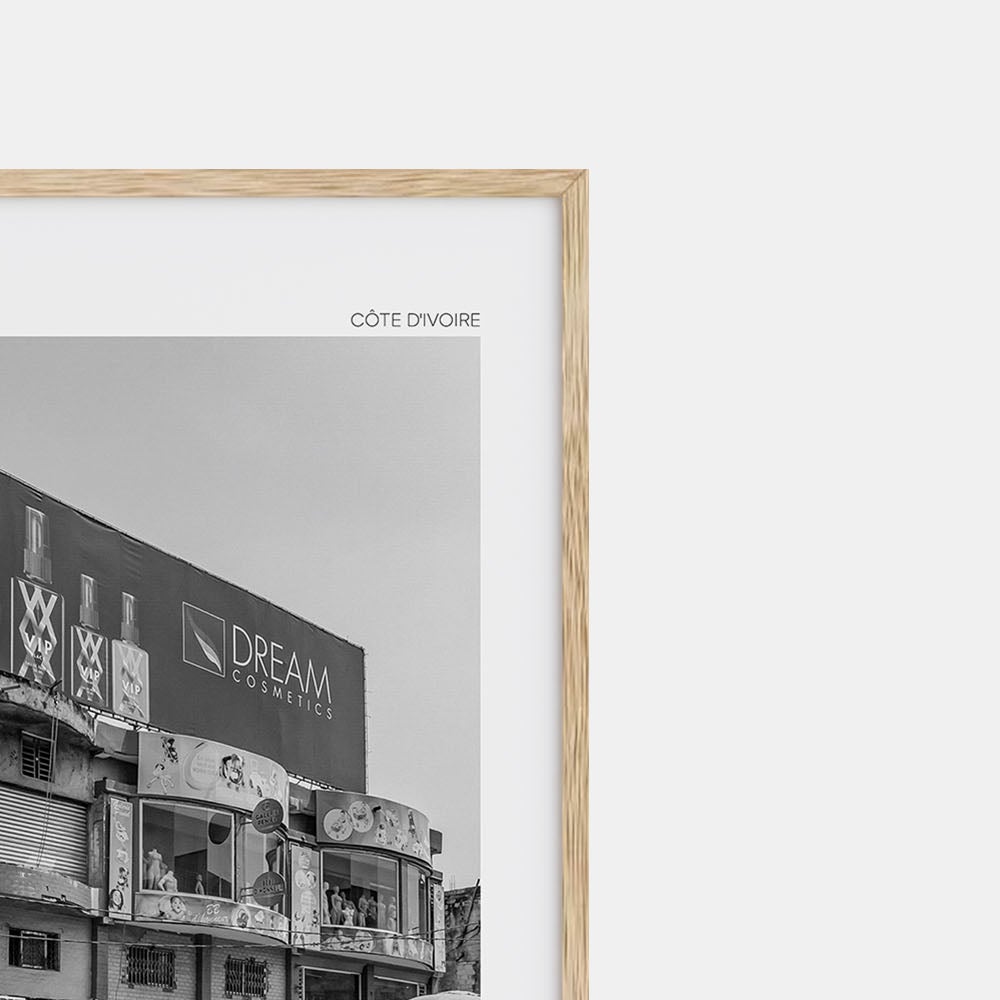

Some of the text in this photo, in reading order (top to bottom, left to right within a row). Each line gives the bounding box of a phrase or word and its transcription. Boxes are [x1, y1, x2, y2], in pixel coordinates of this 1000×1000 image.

[350, 308, 481, 328] CÔTE D'IVOIRE
[24, 631, 53, 655] VIP
[81, 664, 100, 681] VIP
[233, 624, 332, 705] DREAM
[121, 679, 142, 695] VIP
[232, 669, 333, 720] COSMETICS
